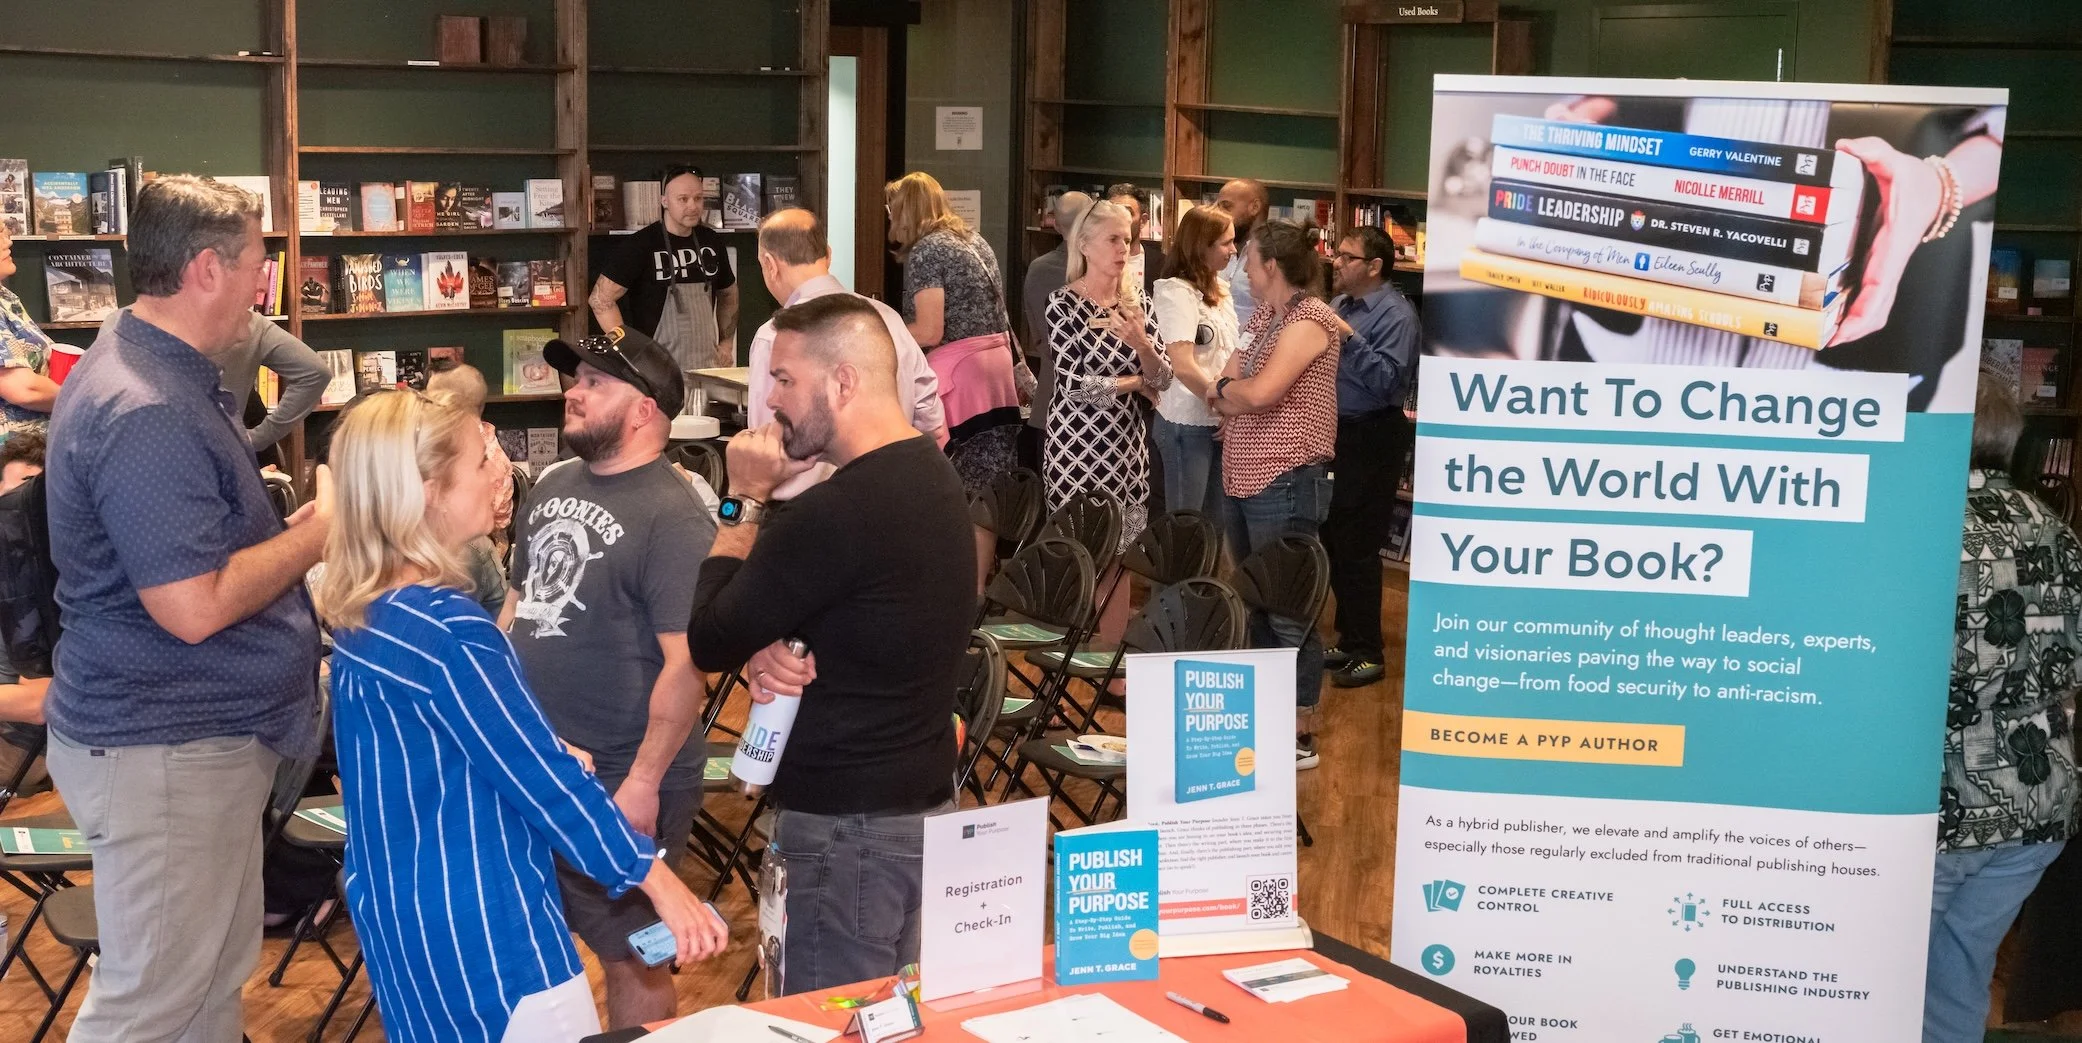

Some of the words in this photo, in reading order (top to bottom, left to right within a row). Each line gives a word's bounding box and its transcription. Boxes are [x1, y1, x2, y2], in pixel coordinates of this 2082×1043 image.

[1399, 7, 1416, 16] Used
[1417, 6, 1439, 16] Books
[1523, 124, 1545, 142] THE
[1548, 126, 1603, 149] THRIVING
[1605, 133, 1663, 157] MINDSET
[1689, 147, 1722, 159] GERRY
[1725, 151, 1782, 167] VALENTINE
[1511, 156, 1541, 173] PUNCH
[1543, 160, 1574, 178] DOUBT
[1576, 166, 1586, 179] IN
[1589, 167, 1608, 183] THE
[1610, 170, 1636, 187] FACE
[1674, 179, 1717, 198] NICOLLE
[1718, 185, 1765, 205] MERRILL
[725, 192, 760, 218] BLACK
[726, 205, 760, 223] SQUARE
[1495, 189, 1533, 213] PRIDE
[1538, 197, 1625, 228] LEADERSHIP
[1650, 218, 1668, 230] DR.
[1671, 222, 1710, 237] STEVEN
[1713, 228, 1723, 238] R.
[1726, 231, 1787, 248] YACOVELLI
[1545, 239, 1591, 265] Company
[1593, 247, 1604, 263] of
[1607, 246, 1631, 264] Men
[1653, 256, 1685, 273] Eileen
[1688, 261, 1722, 284] Scully
[349, 274, 383, 293] BIRDS
[1583, 286, 1647, 310] RIDICULOUSLY
[1648, 301, 1694, 320] AMAZING
[1698, 310, 1742, 328] SCHOOLS
[1449, 372, 1589, 416] Want
[1605, 378, 1662, 419] To
[1681, 380, 1882, 438] Change
[1444, 455, 1525, 495] the
[1542, 456, 1700, 501] World
[1717, 463, 1842, 508] With
[528, 497, 625, 546] GOONIES
[1440, 532, 1554, 576] Your
[1568, 537, 1724, 583] Book?
[1433, 612, 1470, 633] Join
[1476, 618, 1508, 634] our
[1513, 618, 1615, 642] community
[1619, 620, 1640, 640] of
[1645, 622, 1716, 646] thought
[1721, 624, 1797, 649] leaders,
[1802, 633, 1878, 655] experts,
[1434, 641, 1468, 661] and
[1474, 644, 1572, 665] visionaries
[1577, 650, 1640, 671] paving
[1646, 650, 1676, 669] the
[1680, 657, 1717, 676] way
[1722, 656, 1741, 672] to
[1747, 656, 1802, 676] social
[1185, 670, 1244, 689] PUBLISH
[1185, 692, 1225, 710] YOUR
[1567, 675, 1611, 695] food
[1616, 679, 1688, 702] security
[1693, 682, 1711, 699] to
[1716, 684, 1823, 707] anti-racism.
[1185, 713, 1249, 732] PURPOSE
[748, 723, 780, 750] IDE
[1430, 727, 1509, 746] BECOME
[1516, 733, 1529, 747] A
[1537, 734, 1572, 749] PYP
[1579, 736, 1659, 752] AUTHOR
[1186, 784, 1207, 794] JENN
[1216, 779, 1240, 789] GRACE
[1426, 815, 1442, 827] As
[1446, 819, 1454, 828] a
[1458, 817, 1499, 832] hybrid
[1504, 820, 1567, 836] publisher,
[1572, 827, 1590, 836] we
[1595, 824, 1640, 838] elevate
[1644, 827, 1668, 839] and
[1672, 829, 1720, 845] amplify
[1725, 831, 1744, 844] the
[1750, 834, 1791, 848] voices
[1795, 836, 1809, 849] of
[1069, 849, 1143, 871] PUBLISH
[1424, 840, 1487, 856] especially
[1491, 843, 1525, 855] those
[1530, 846, 1586, 862] regularly
[1590, 849, 1648, 862] excluded
[1653, 850, 1682, 863] from
[1687, 852, 1752, 868] traditional
[1756, 858, 1826, 877] publishing
[1831, 862, 1881, 877] houses.
[945, 875, 1023, 897] Registration
[1068, 872, 1116, 891] YOUR
[1069, 892, 1149, 914] PURPOSE
[1478, 885, 1546, 898] COMPLETE
[1551, 889, 1614, 902] CREATIVE
[1477, 901, 1540, 913] CONTROL
[1722, 898, 1753, 910] FULL
[1758, 902, 1811, 915] ACCESS
[954, 914, 1012, 933] Check-In
[1721, 914, 1738, 925] TO
[1743, 916, 1836, 932] DISTRIBUTION
[1474, 950, 1511, 961] MAKE
[1516, 952, 1553, 963] MORE
[1559, 955, 1572, 964] IN
[1069, 966, 1094, 975] JENN
[1095, 965, 1104, 973] T.
[1104, 963, 1137, 972] GRACE
[1473, 965, 1542, 978] ROYALTIES
[1717, 964, 1808, 981] UNDERSTAND
[1813, 972, 1838, 983] THE
[1716, 980, 1798, 996] PUBLISHING
[1803, 987, 1871, 1001] INDUSTRY
[1508, 1016, 1535, 1026] OUR
[1540, 1018, 1578, 1029] BOOK
[1713, 1028, 1739, 1039] GET
[1510, 1031, 1537, 1041] WED
